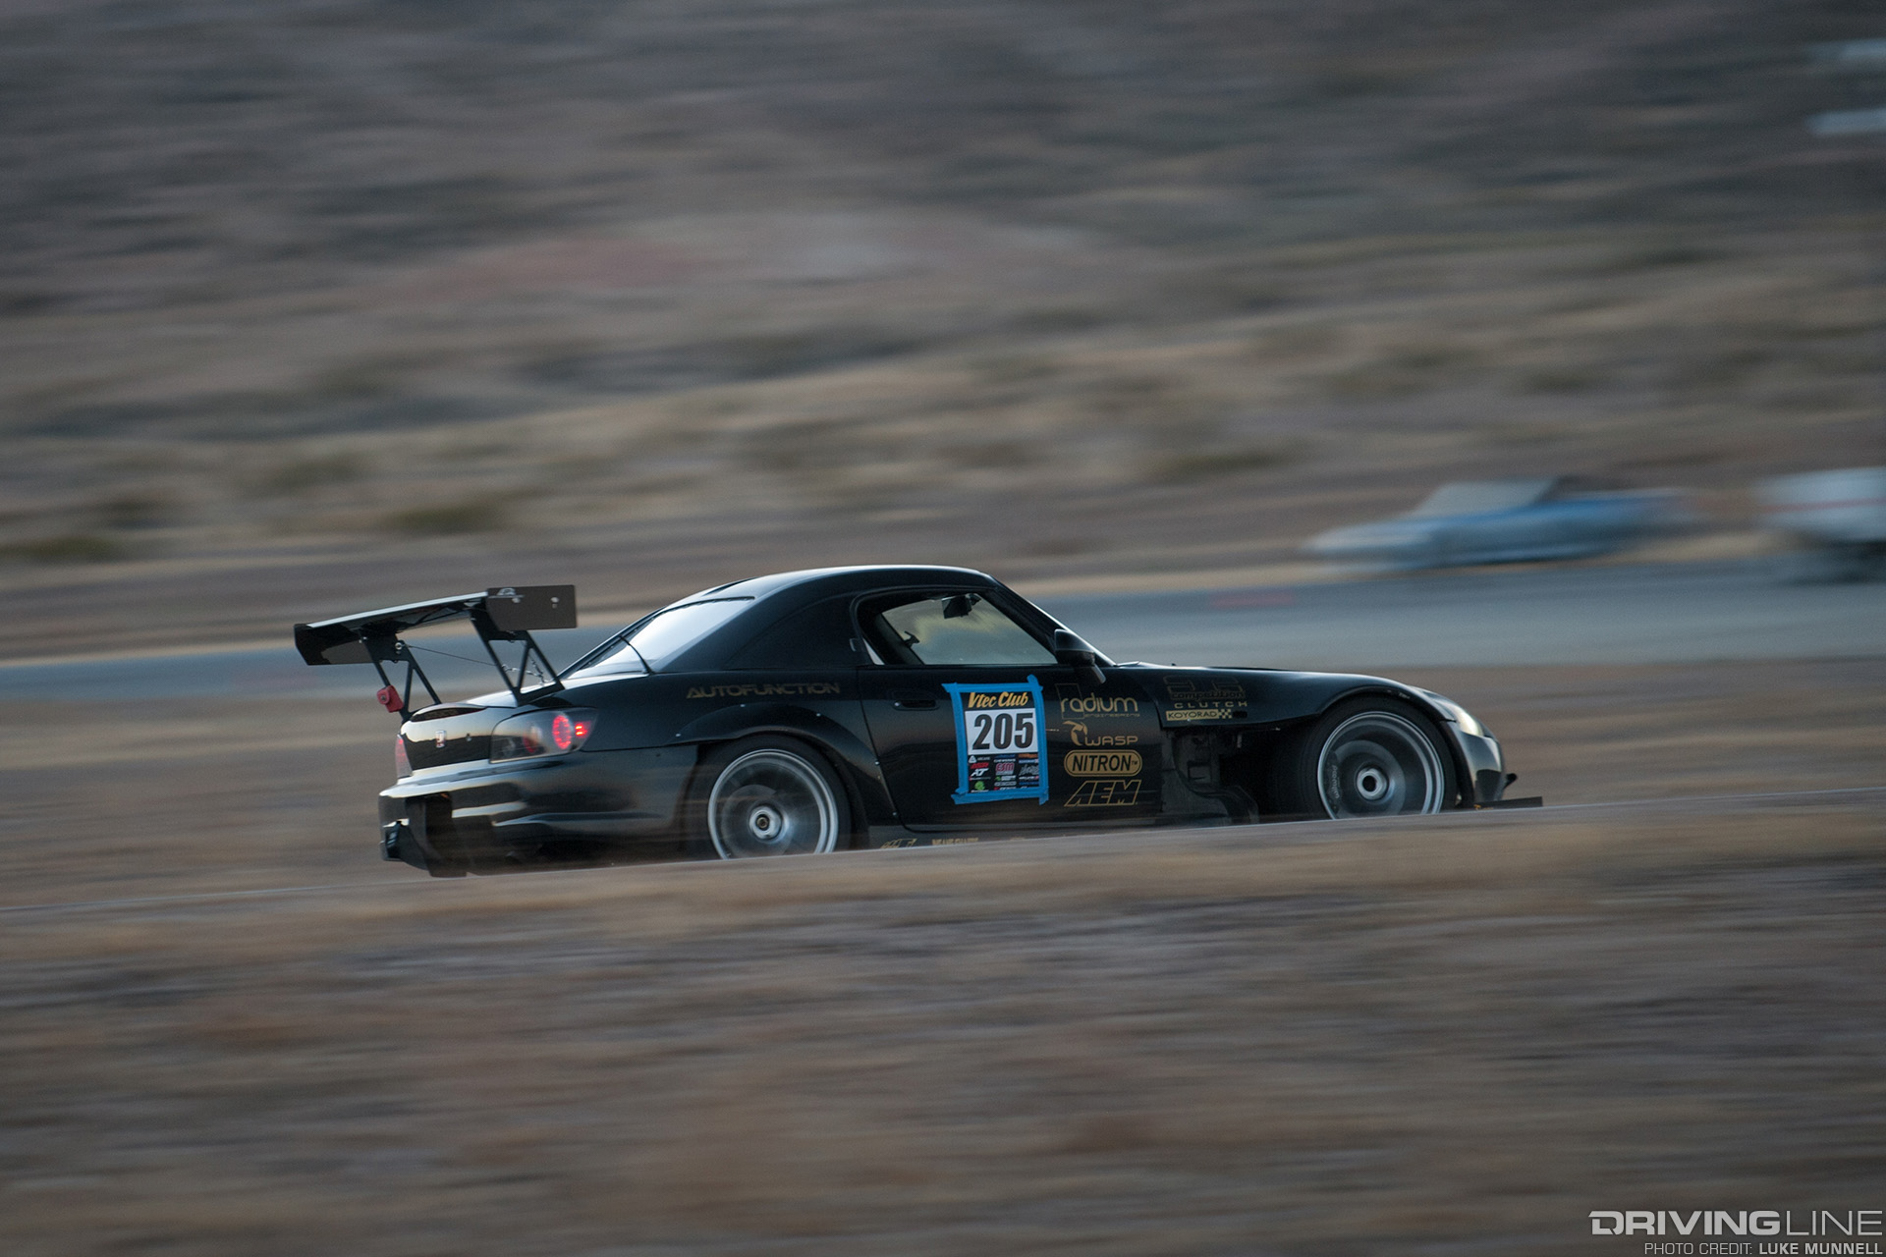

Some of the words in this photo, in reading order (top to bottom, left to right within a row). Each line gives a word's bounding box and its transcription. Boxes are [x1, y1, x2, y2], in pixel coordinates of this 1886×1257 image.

[686, 683, 841, 699] AUTOFUNCTION
[967, 691, 997, 708] Vtec
[997, 691, 1028, 707] Club
[1061, 692, 1139, 713] radium
[1174, 701, 1248, 709] CLUTCH
[1167, 711, 1218, 719] KOYORAD
[972, 712, 1034, 750] 205
[1072, 754, 1132, 772] NITRON
[1064, 779, 1142, 807] AEM
